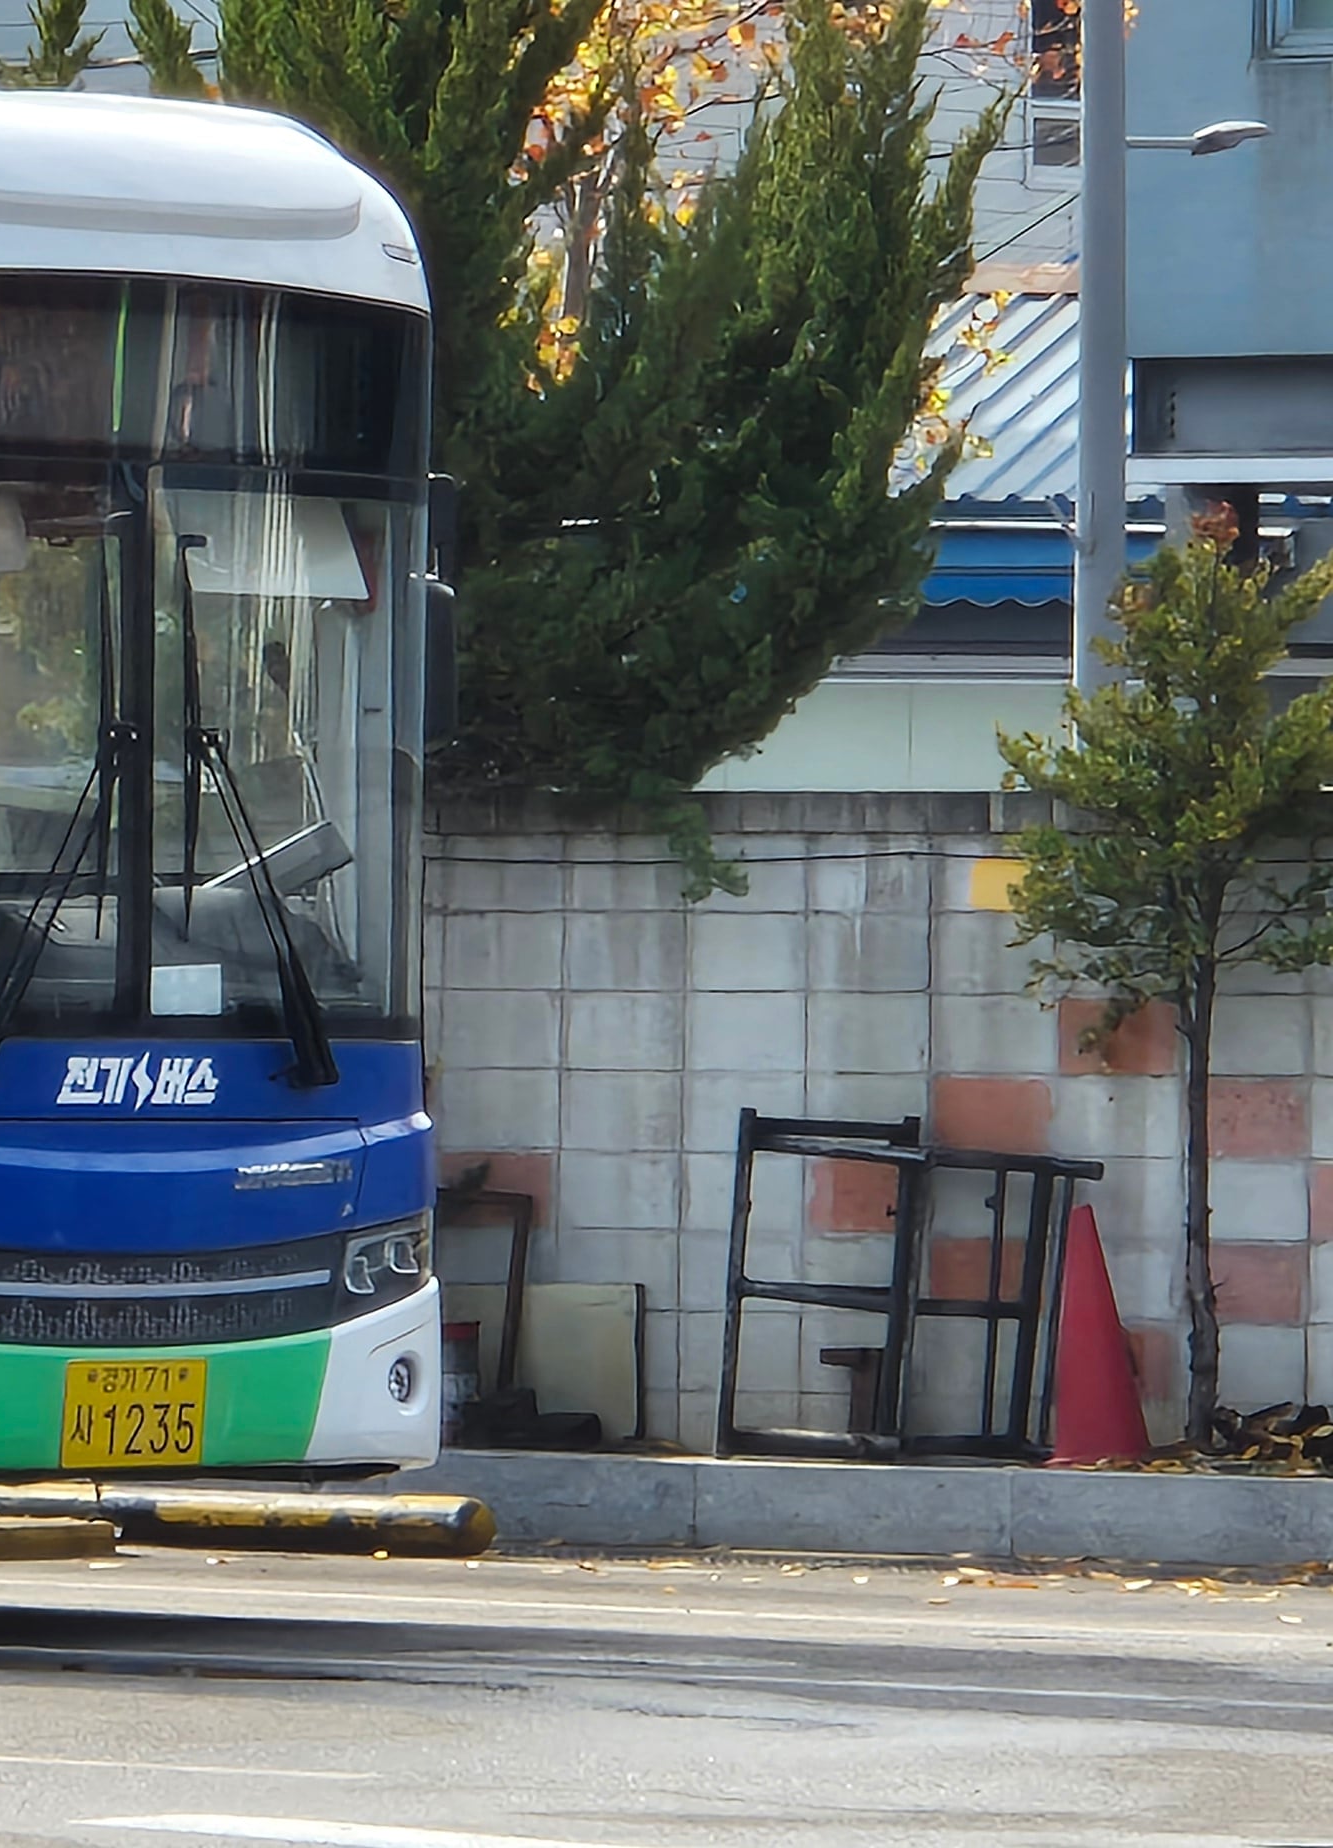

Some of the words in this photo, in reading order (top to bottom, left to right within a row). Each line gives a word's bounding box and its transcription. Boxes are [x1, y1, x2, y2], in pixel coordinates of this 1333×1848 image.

[101, 1367, 137, 1393] 경기
[143, 1366, 170, 1392] 71
[70, 1404, 94, 1445] 사
[104, 1403, 195, 1456] 1235
